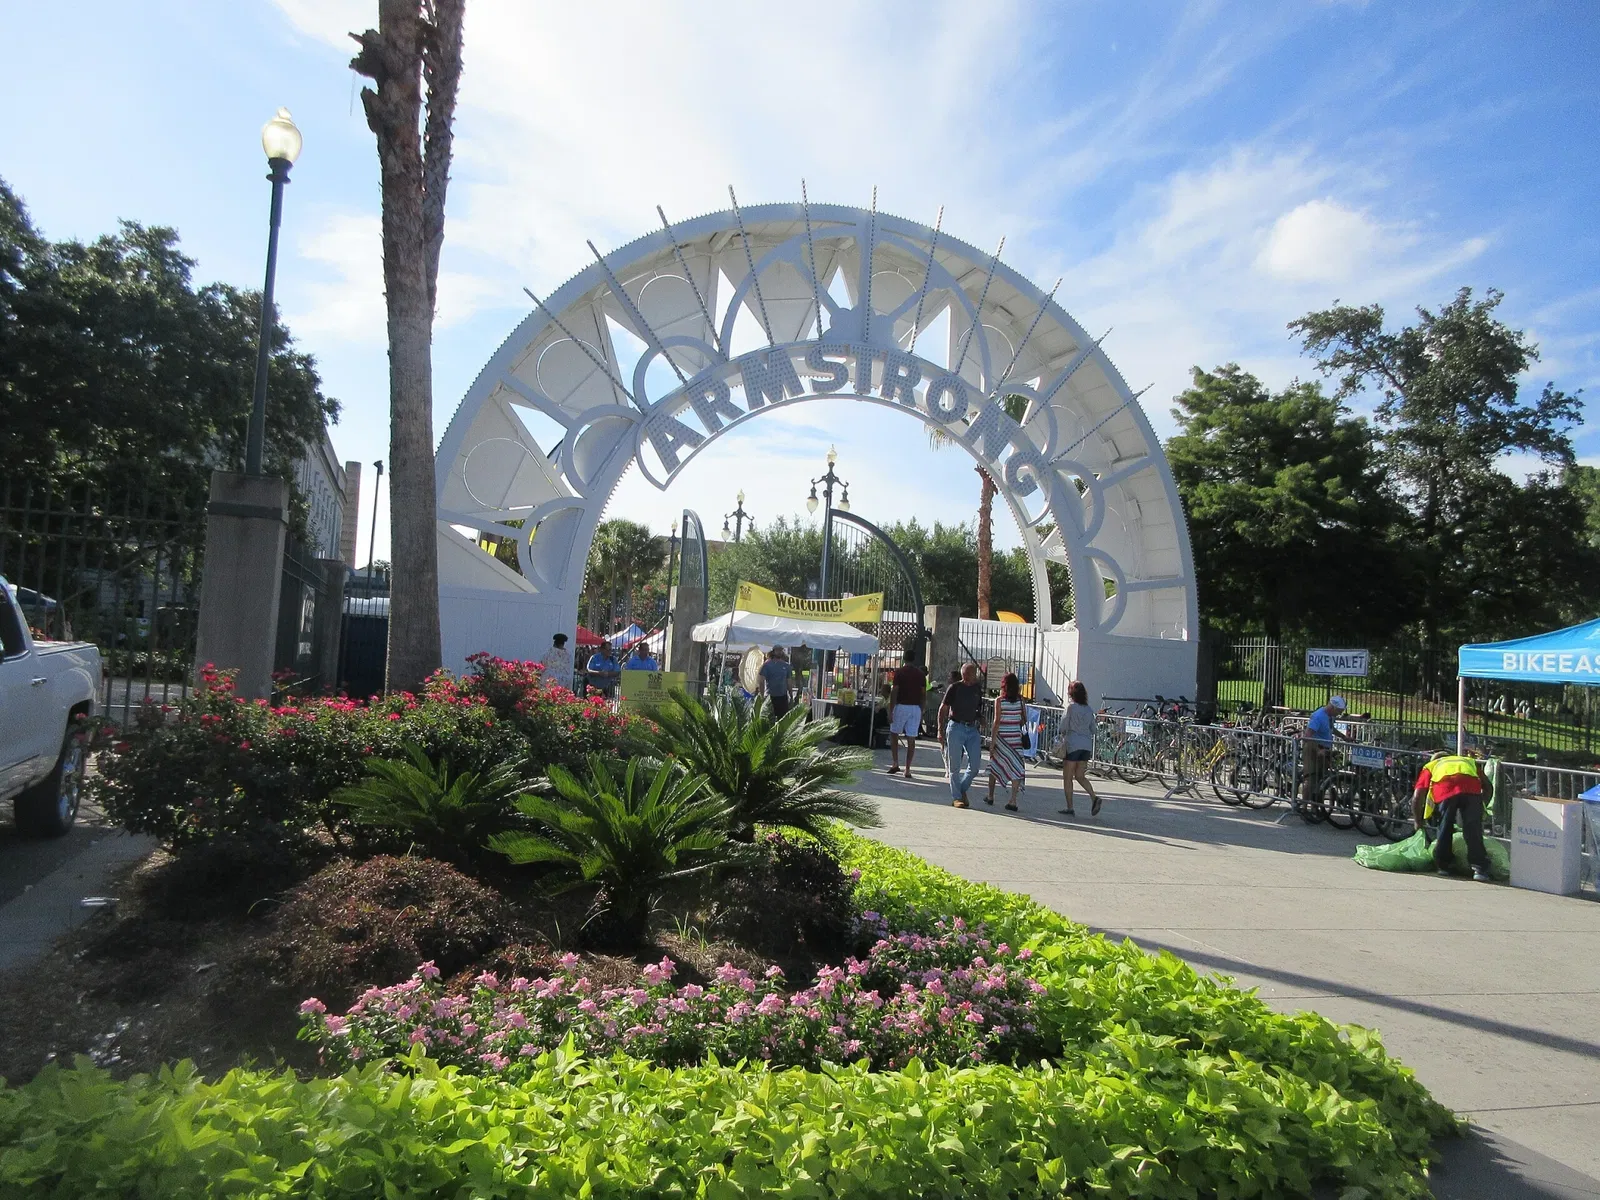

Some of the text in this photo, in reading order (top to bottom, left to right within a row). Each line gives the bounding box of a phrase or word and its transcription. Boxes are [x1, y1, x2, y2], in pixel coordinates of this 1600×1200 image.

[645, 342, 1049, 498] ARMSTRONG
[775, 592, 843, 612] Welcome!
[1308, 654, 1365, 669] BIKE VALET
